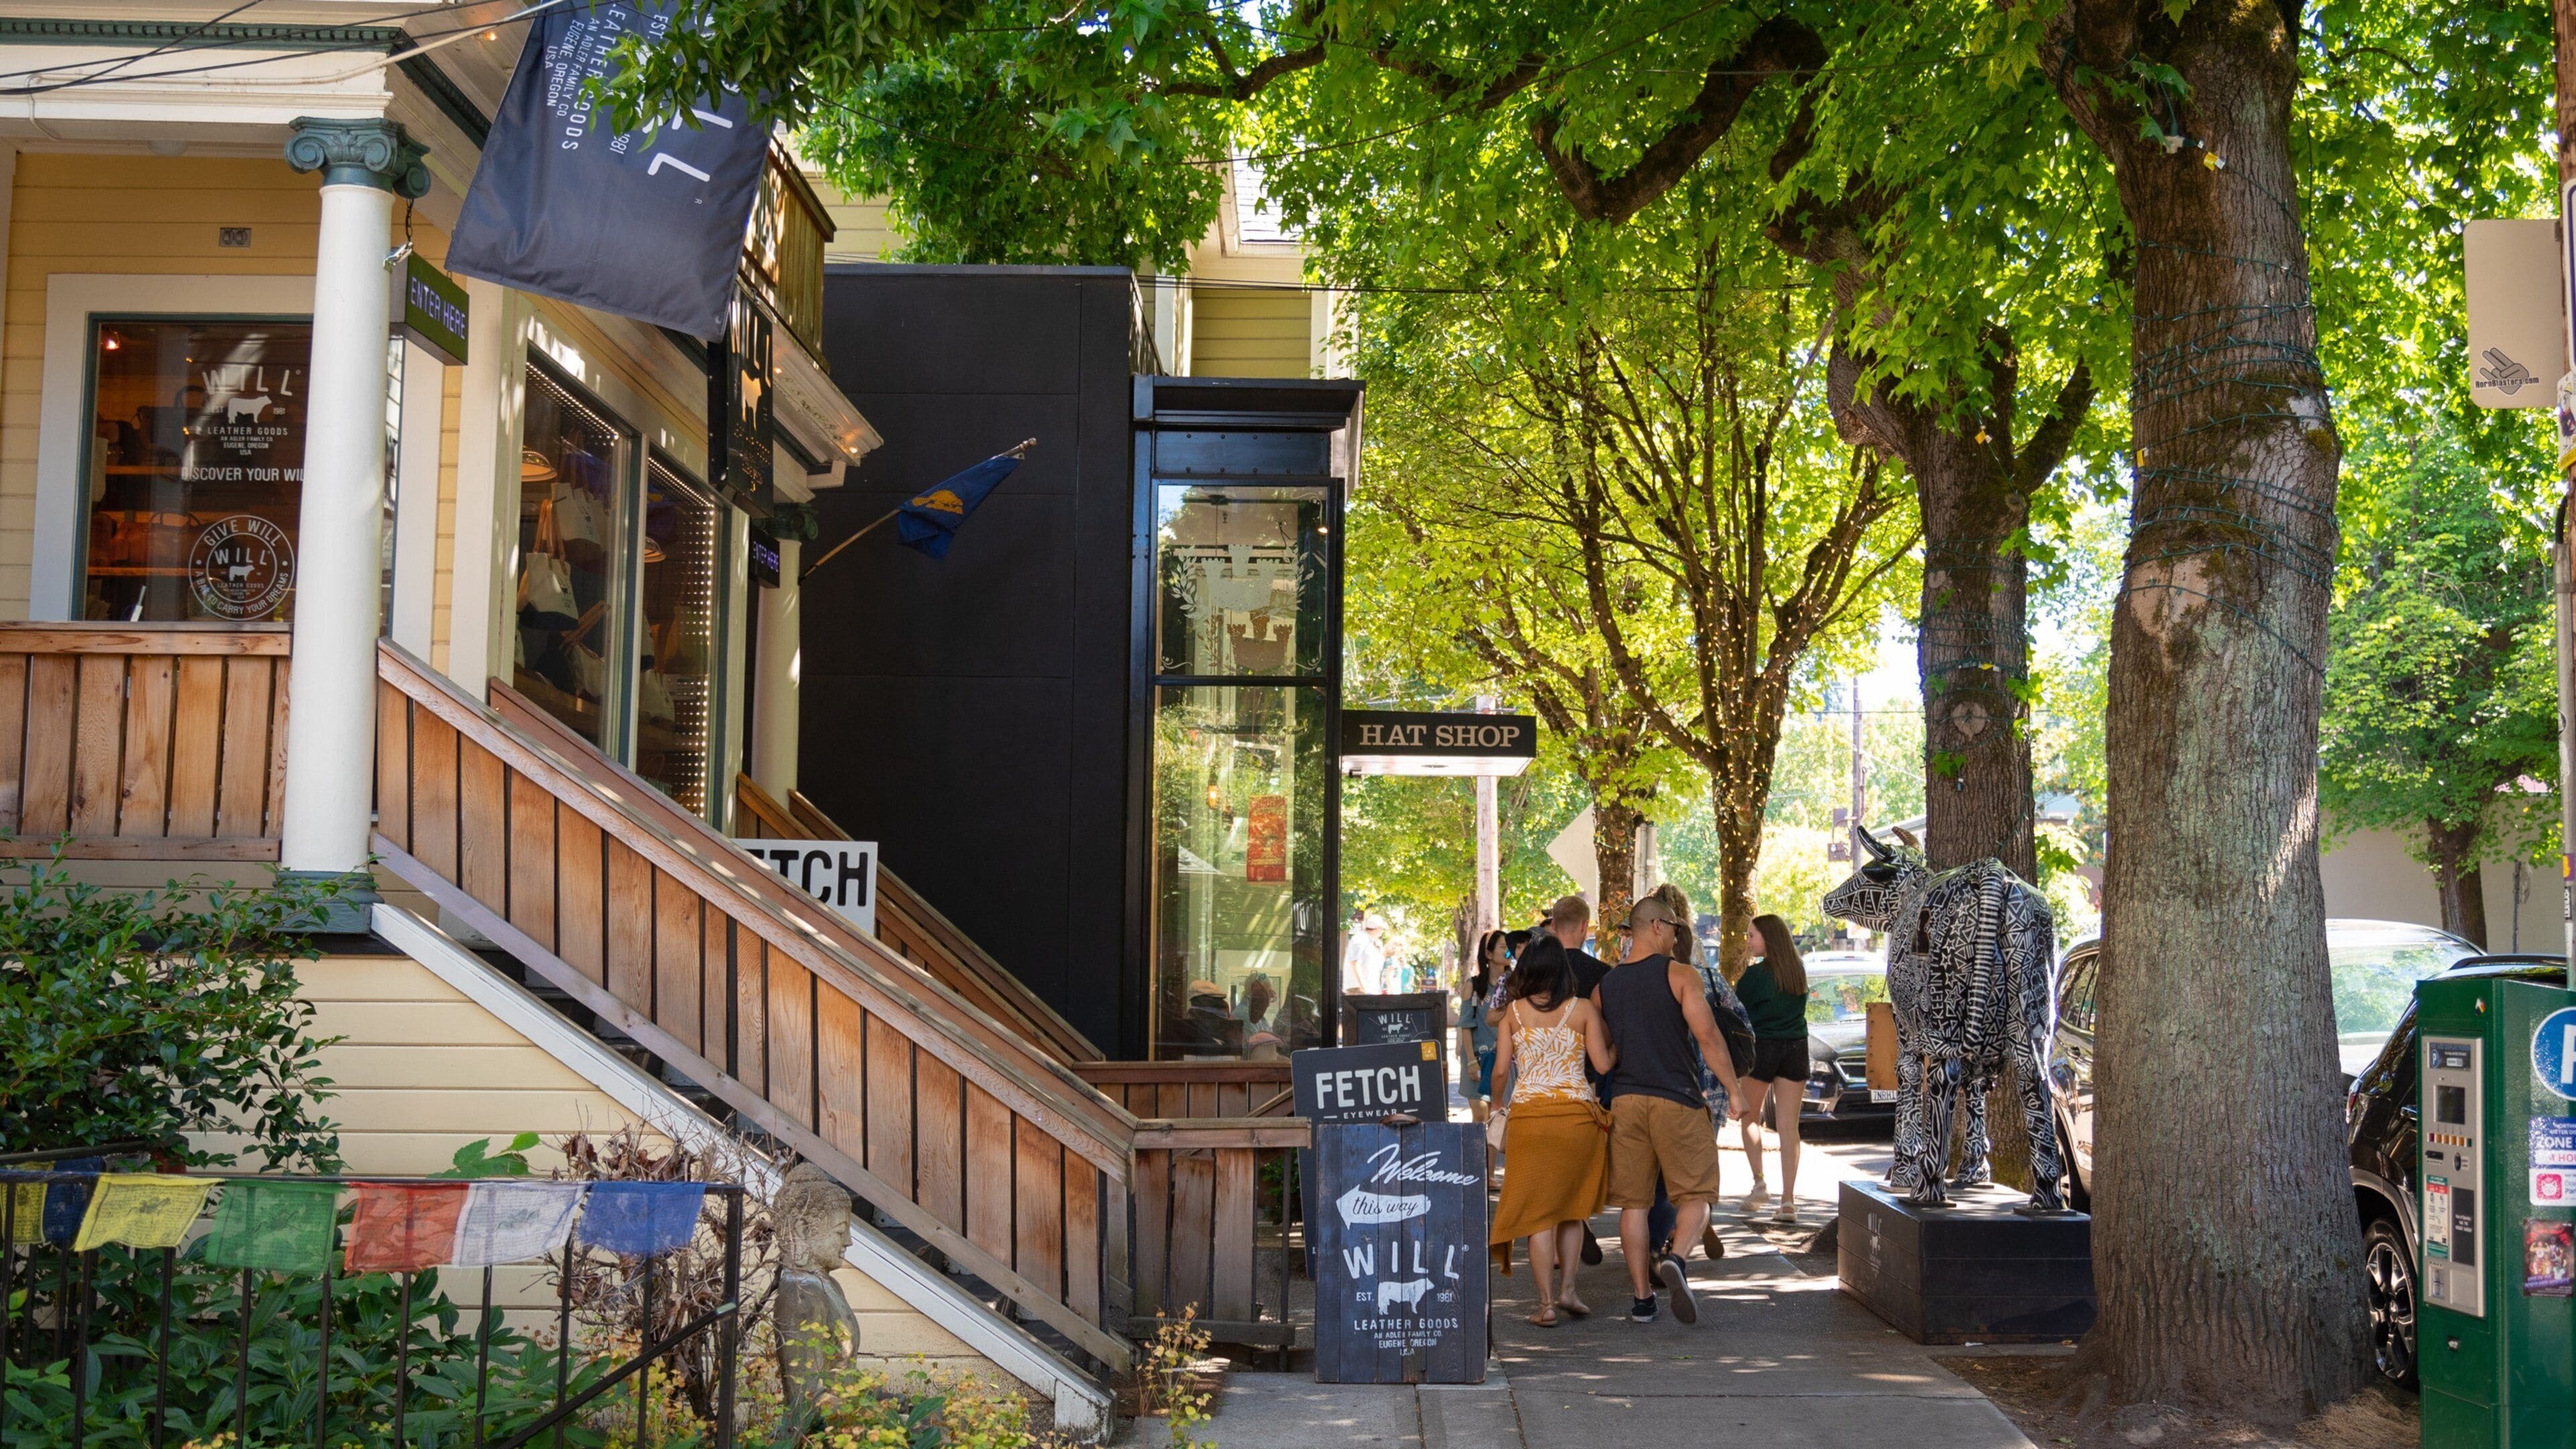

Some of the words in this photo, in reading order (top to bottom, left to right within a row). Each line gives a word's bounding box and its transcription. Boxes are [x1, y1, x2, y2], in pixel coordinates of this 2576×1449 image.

[587, 17, 600, 33] AN
[545, 45, 553, 69] USA
[576, 34, 595, 63] ADLER
[546, 62, 568, 107] OREGON
[567, 62, 583, 100] FAMILY
[411, 276, 441, 322] ENTER
[443, 301, 466, 340] HERE
[2475, 377, 2539, 388] HornBlasters.com
[207, 427, 252, 435] LEATHER
[258, 427, 288, 435] GOODS
[246, 468, 279, 480] YOUR
[203, 519, 239, 547] GIVE
[248, 519, 281, 547] WILL
[217, 601, 244, 614] CARRY
[246, 600, 268, 614] YOUR
[266, 572, 289, 603] DREAMS
[1359, 724, 1427, 746] HAT
[1436, 725, 1520, 747] SHOP
[1316, 1065, 1421, 1109] FETCH
[1344, 1109, 1397, 1119] EYEWEAR
[2536, 1136, 2573, 1148] ZONE
[1367, 1143, 1479, 1185] Welcome
[1352, 1196, 1382, 1215] this
[1387, 1201, 1419, 1216] way
[1356, 1292, 1374, 1301] EST.
[1436, 1293, 1453, 1302] 1981
[1354, 1319, 1411, 1330] LEATHER
[1419, 1318, 1458, 1329] GOODS
[1400, 1348, 1415, 1356] USA
[1410, 1338, 1437, 1347] OREGON
